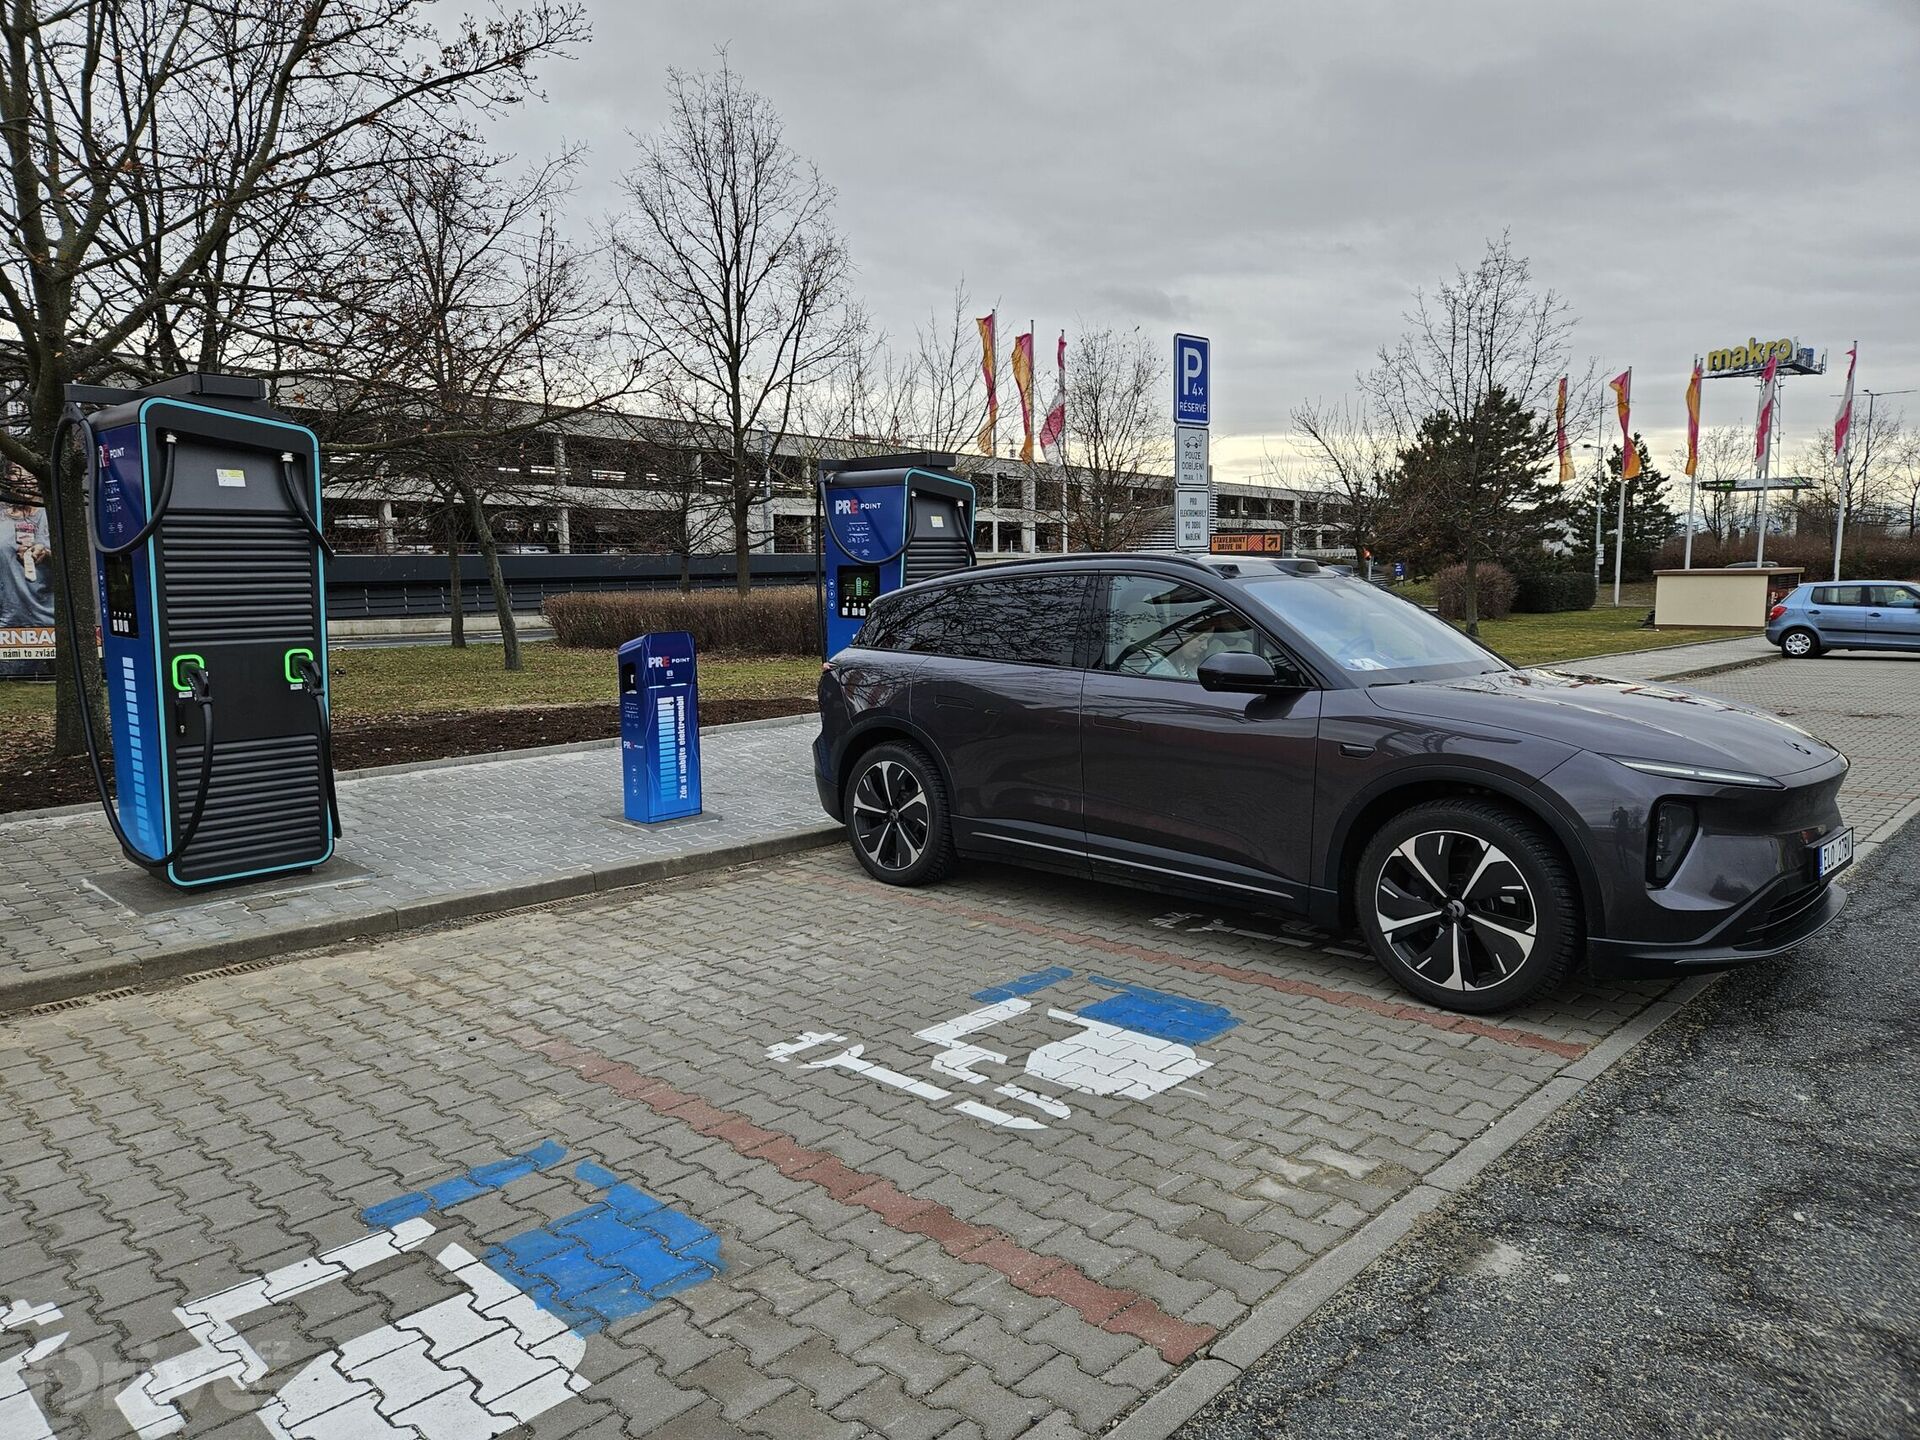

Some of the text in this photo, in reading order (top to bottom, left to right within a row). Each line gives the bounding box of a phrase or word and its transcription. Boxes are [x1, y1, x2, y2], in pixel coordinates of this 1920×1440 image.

[1707, 337, 1792, 371] makro
[1184, 347, 1202, 395] P
[1192, 383, 1204, 396] 4x
[1180, 400, 1206, 414] RÉSERVÉ
[110, 447, 125, 459] POINT
[1185, 451, 1201, 460] POUZE
[836, 500, 858, 514] PRE
[3, 649, 21, 658] námi
[24, 650, 32, 658] to
[648, 656, 670, 668] PRE
[677, 696, 685, 746] elektromobil
[680, 775, 688, 784] si
